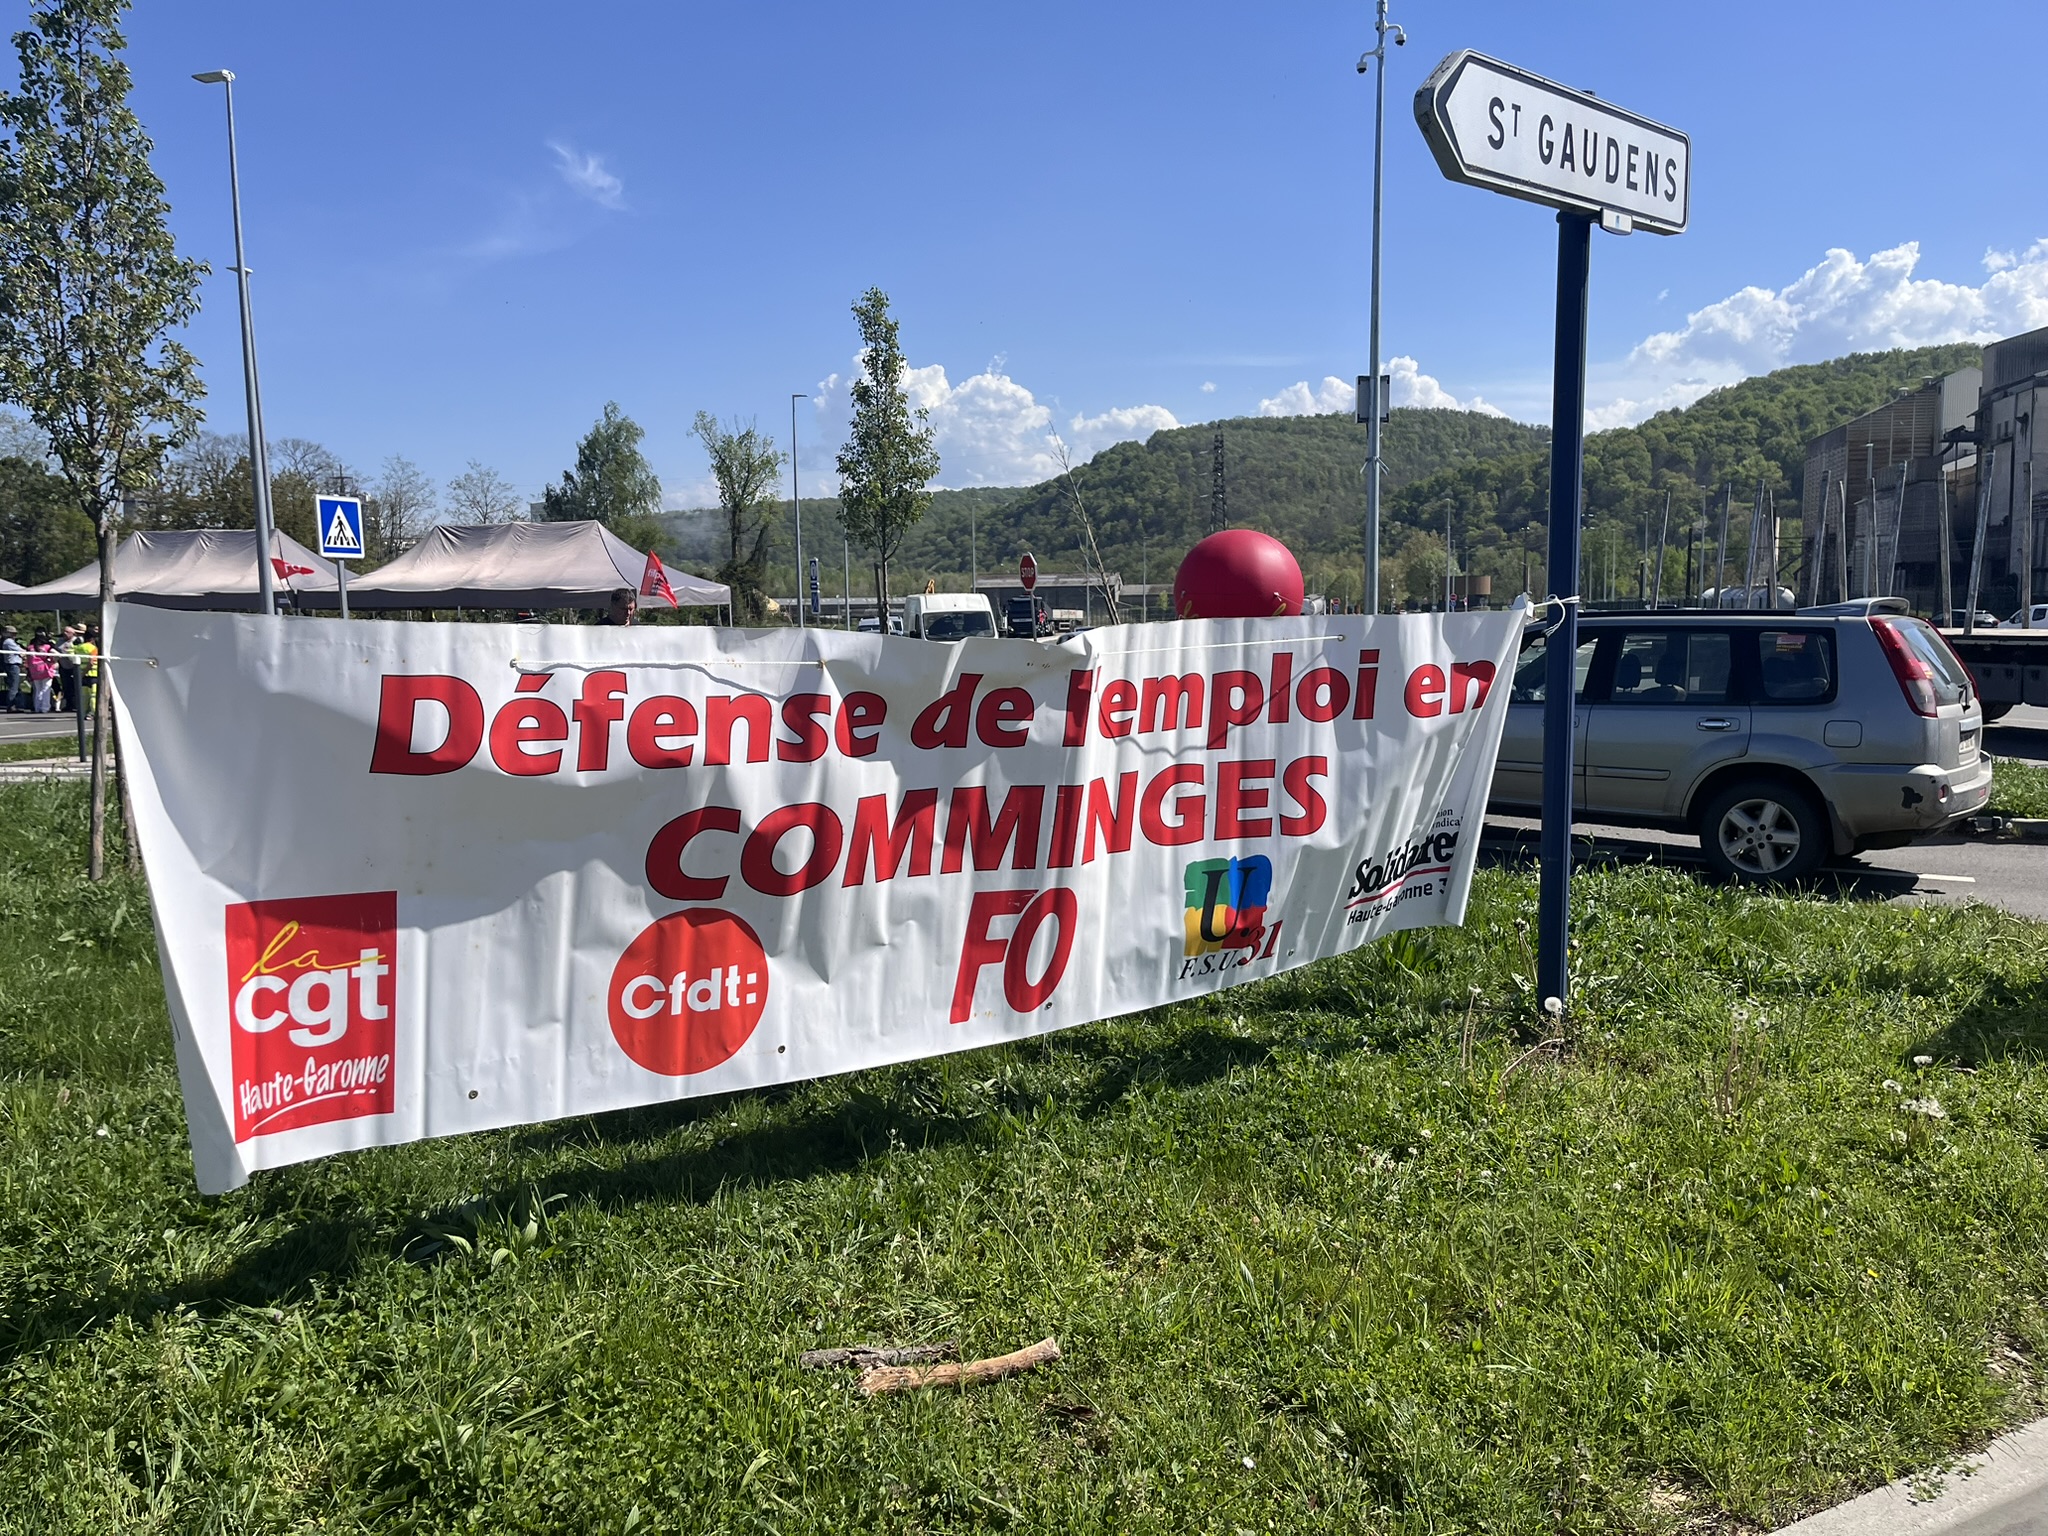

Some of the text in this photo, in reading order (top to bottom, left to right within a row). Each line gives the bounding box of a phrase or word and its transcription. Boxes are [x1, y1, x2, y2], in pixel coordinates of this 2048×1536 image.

[1538, 114, 1677, 203] GAUDENS
[1021, 566, 1035, 579] STOP
[369, 649, 1496, 777] Défense de l'emploi en
[645, 755, 1328, 902] COMMINGES
[1346, 881, 1434, 927] Haute-Garonne
[241, 920, 387, 982] la
[949, 887, 1078, 1025] FO
[235, 948, 390, 1048] cgt
[621, 964, 758, 1020] Cfdt:
[239, 1053, 391, 1121] Haute-Garonne
